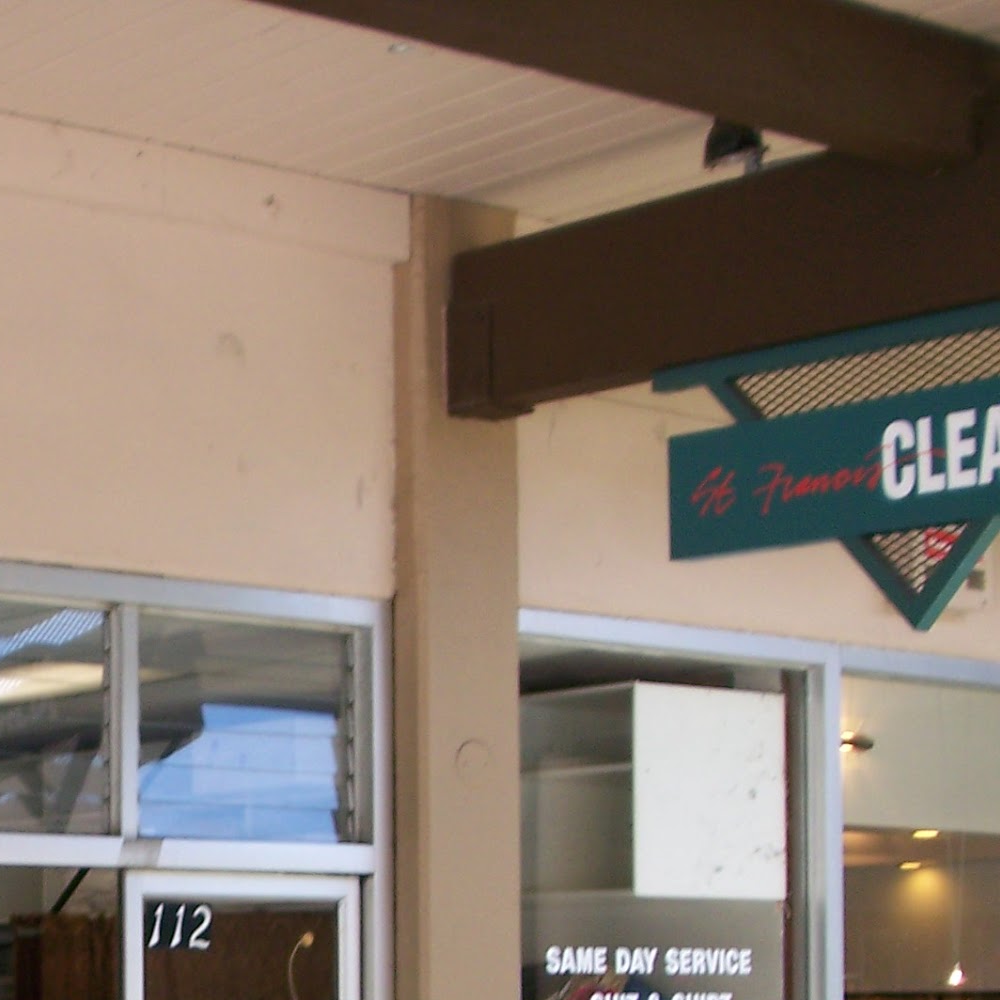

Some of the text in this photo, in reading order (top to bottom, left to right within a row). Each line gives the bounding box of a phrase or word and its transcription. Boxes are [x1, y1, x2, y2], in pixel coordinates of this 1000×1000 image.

[881, 402, 1000, 502] CLEA
[148, 902, 213, 950] 112
[545, 945, 753, 977] SAME DAY SERVICE
